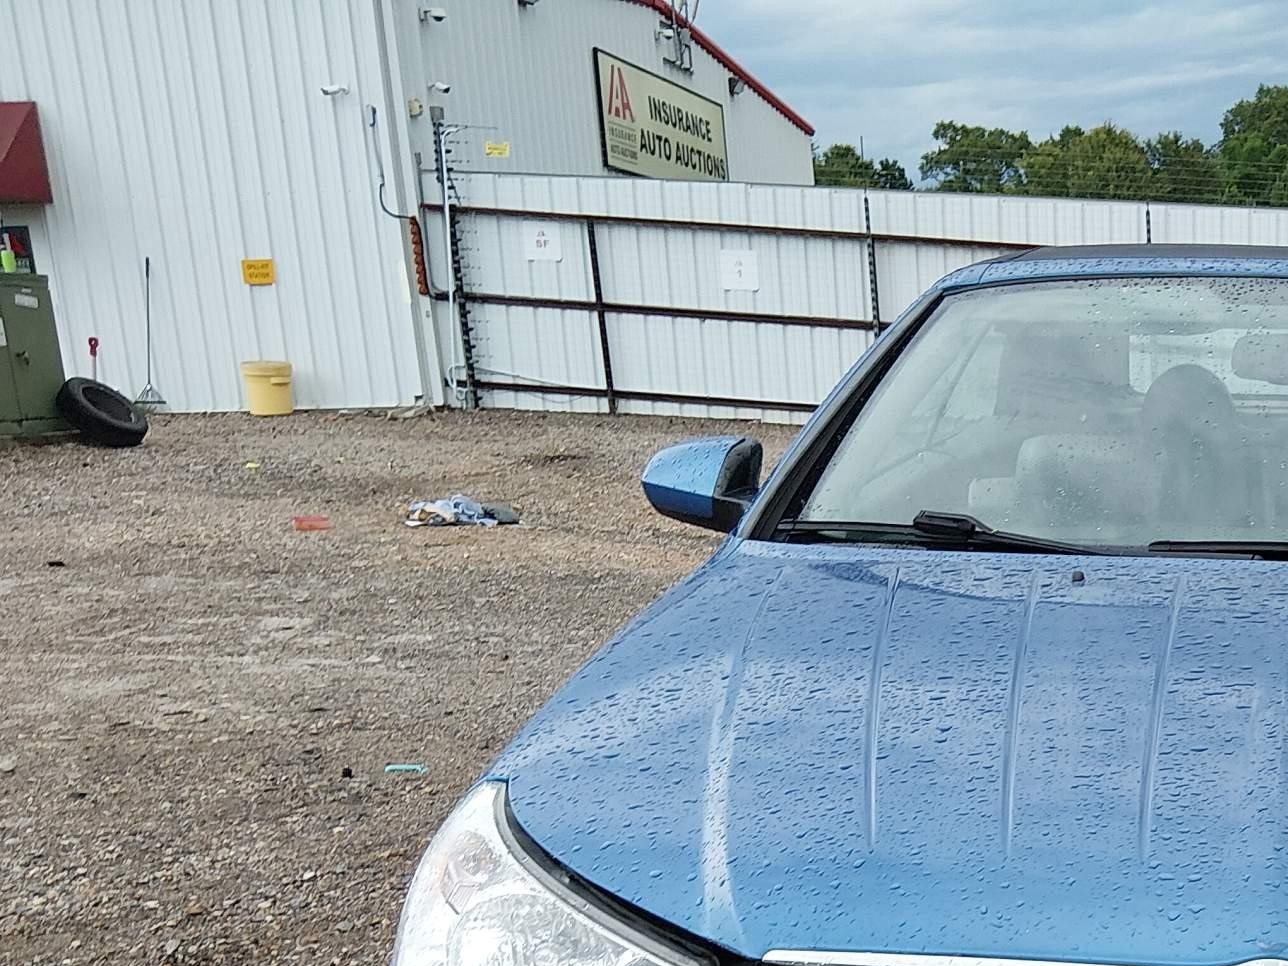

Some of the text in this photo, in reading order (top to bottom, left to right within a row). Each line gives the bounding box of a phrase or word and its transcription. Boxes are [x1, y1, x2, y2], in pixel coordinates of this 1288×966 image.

[648, 95, 712, 143] INSURANCE
[640, 127, 726, 181] AUTO AUCTIONS
